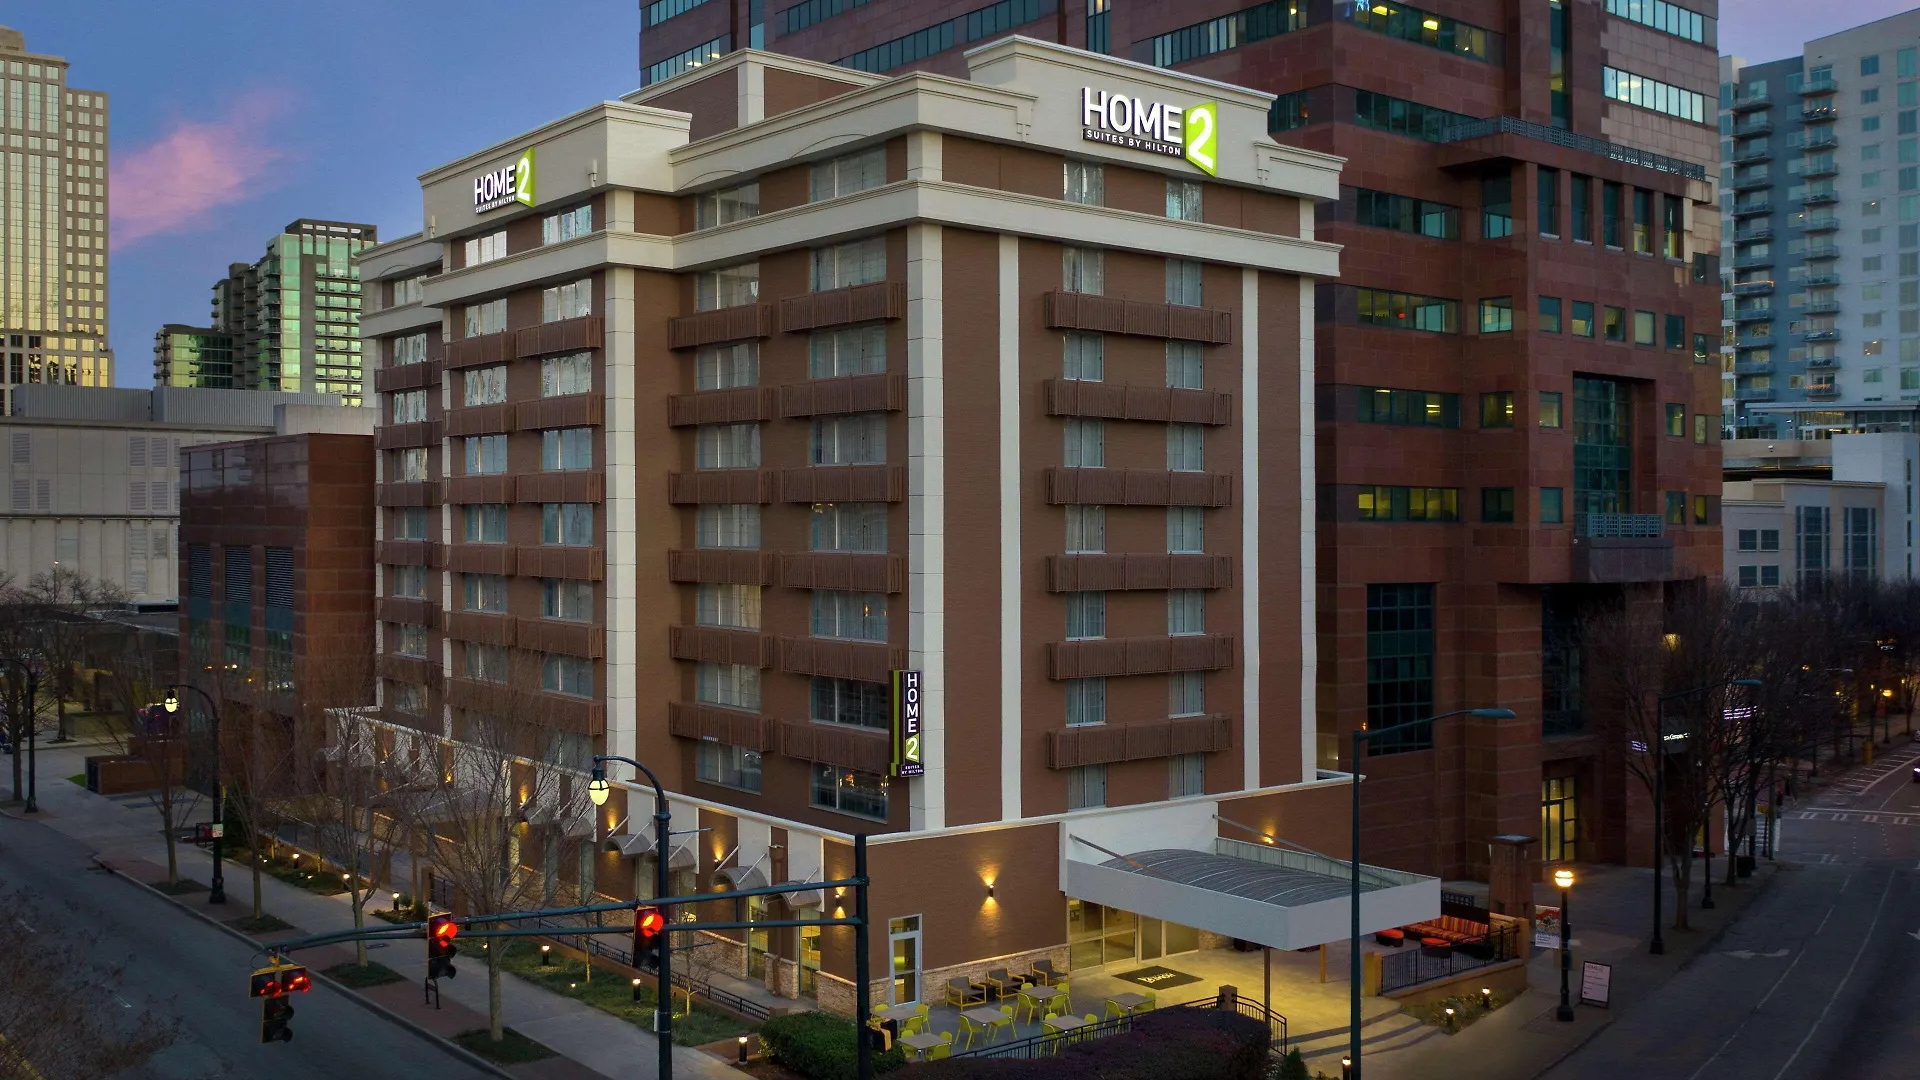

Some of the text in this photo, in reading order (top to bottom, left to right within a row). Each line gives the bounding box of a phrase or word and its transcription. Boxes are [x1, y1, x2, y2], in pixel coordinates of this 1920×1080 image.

[1086, 129, 1181, 156] SUITES BY HILTON
